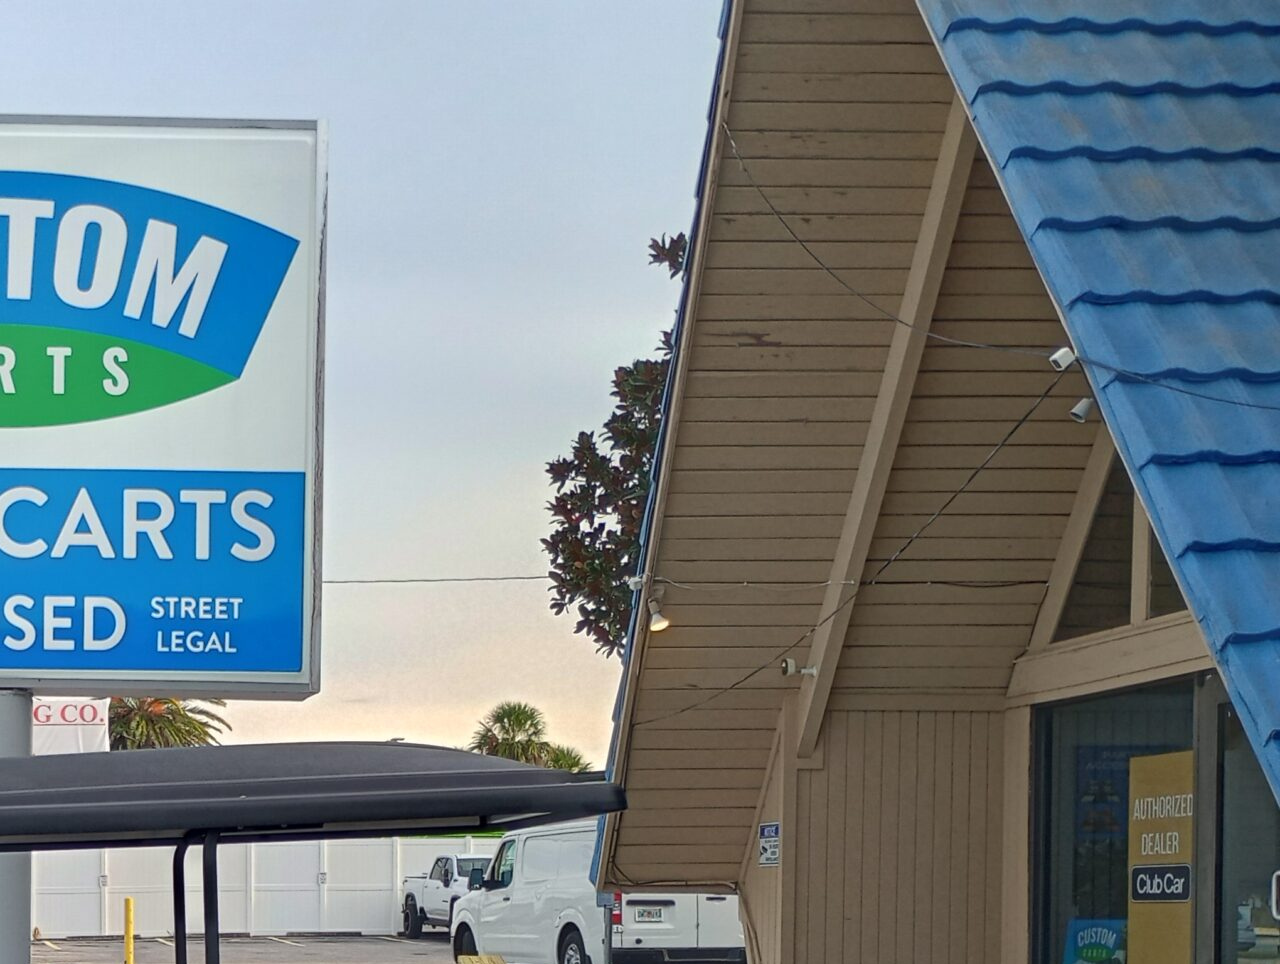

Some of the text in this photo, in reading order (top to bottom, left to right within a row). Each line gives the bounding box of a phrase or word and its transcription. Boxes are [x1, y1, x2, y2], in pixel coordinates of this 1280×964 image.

[150, 597, 243, 620] STREET
[156, 631, 238, 653] LEGAL
[60, 704, 104, 723] CO.
[1133, 794, 1194, 821] AUTHORIZED
[1141, 832, 1179, 855] DEALER
[1136, 873, 1185, 894] Club Car
[1077, 927, 1117, 949] CUSTOM
